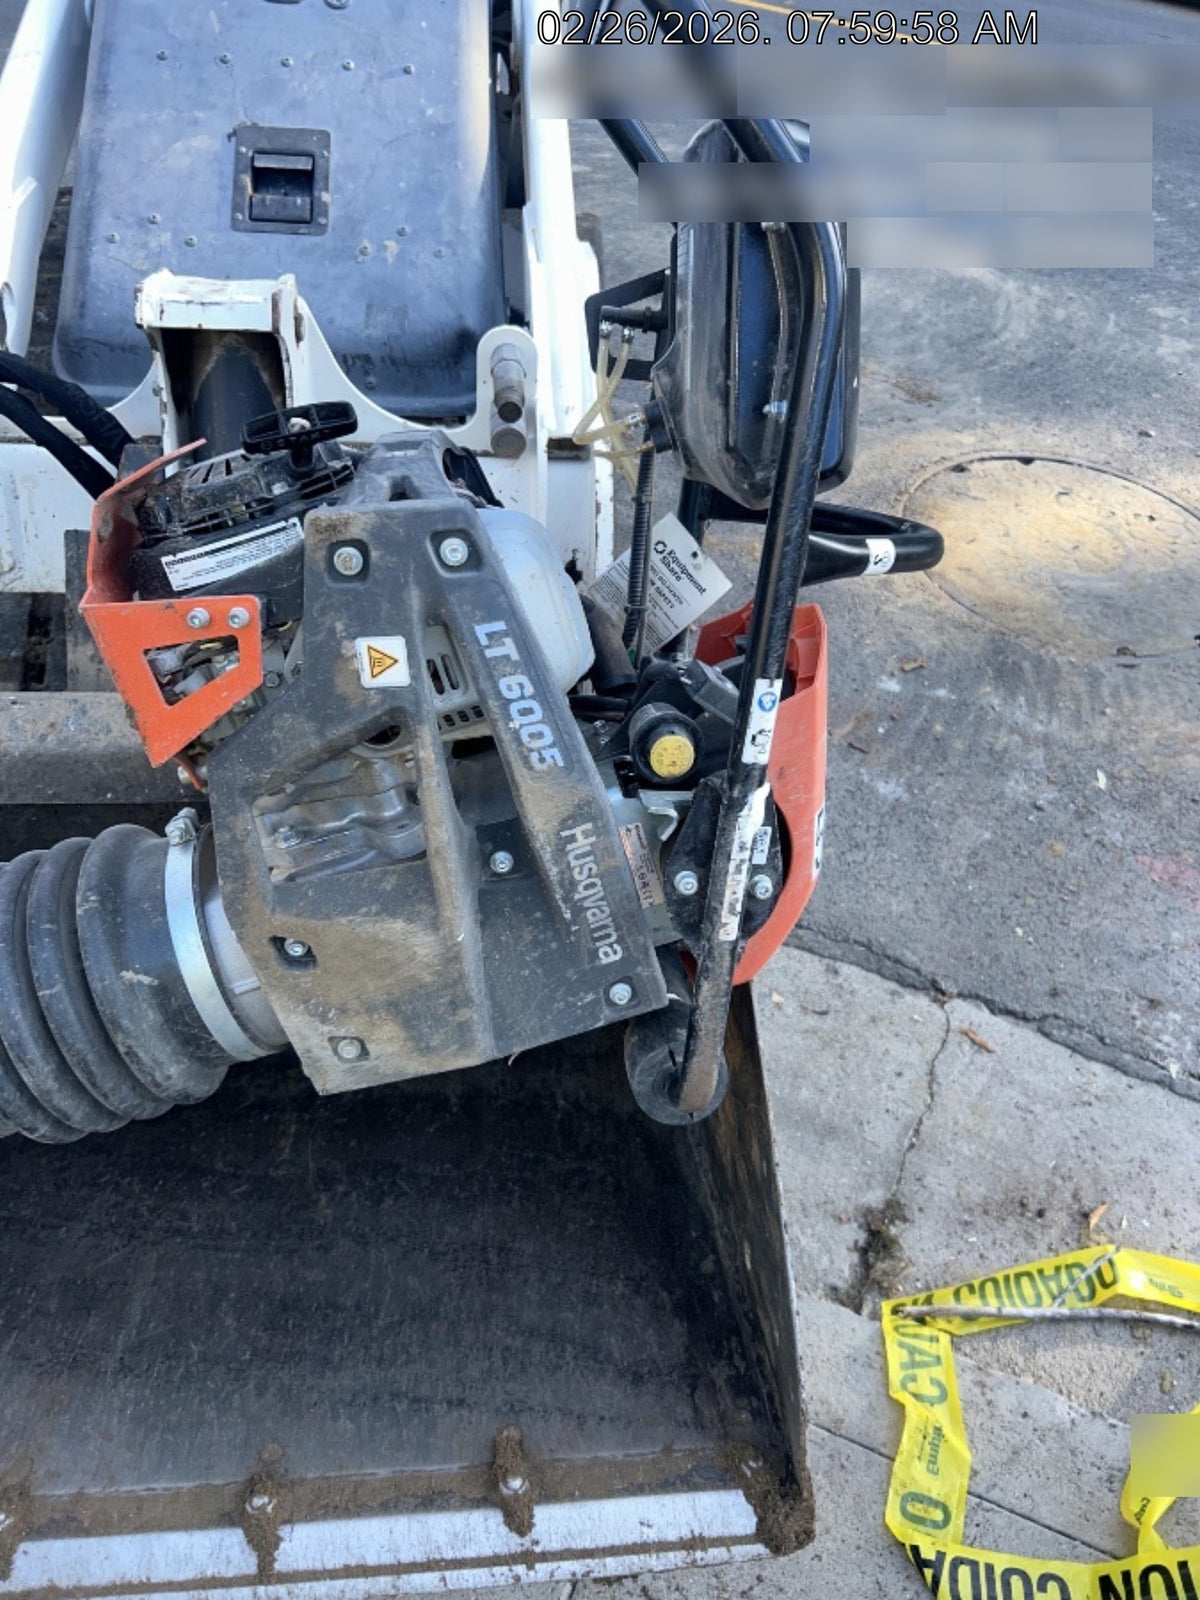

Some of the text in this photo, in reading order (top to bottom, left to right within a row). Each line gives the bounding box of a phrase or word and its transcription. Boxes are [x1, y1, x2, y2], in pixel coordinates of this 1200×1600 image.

[659, 555, 683, 583] Share
[666, 549, 707, 596] Equipment
[473, 620, 565, 773] LT 6005
[559, 821, 624, 965] Husqvarna
